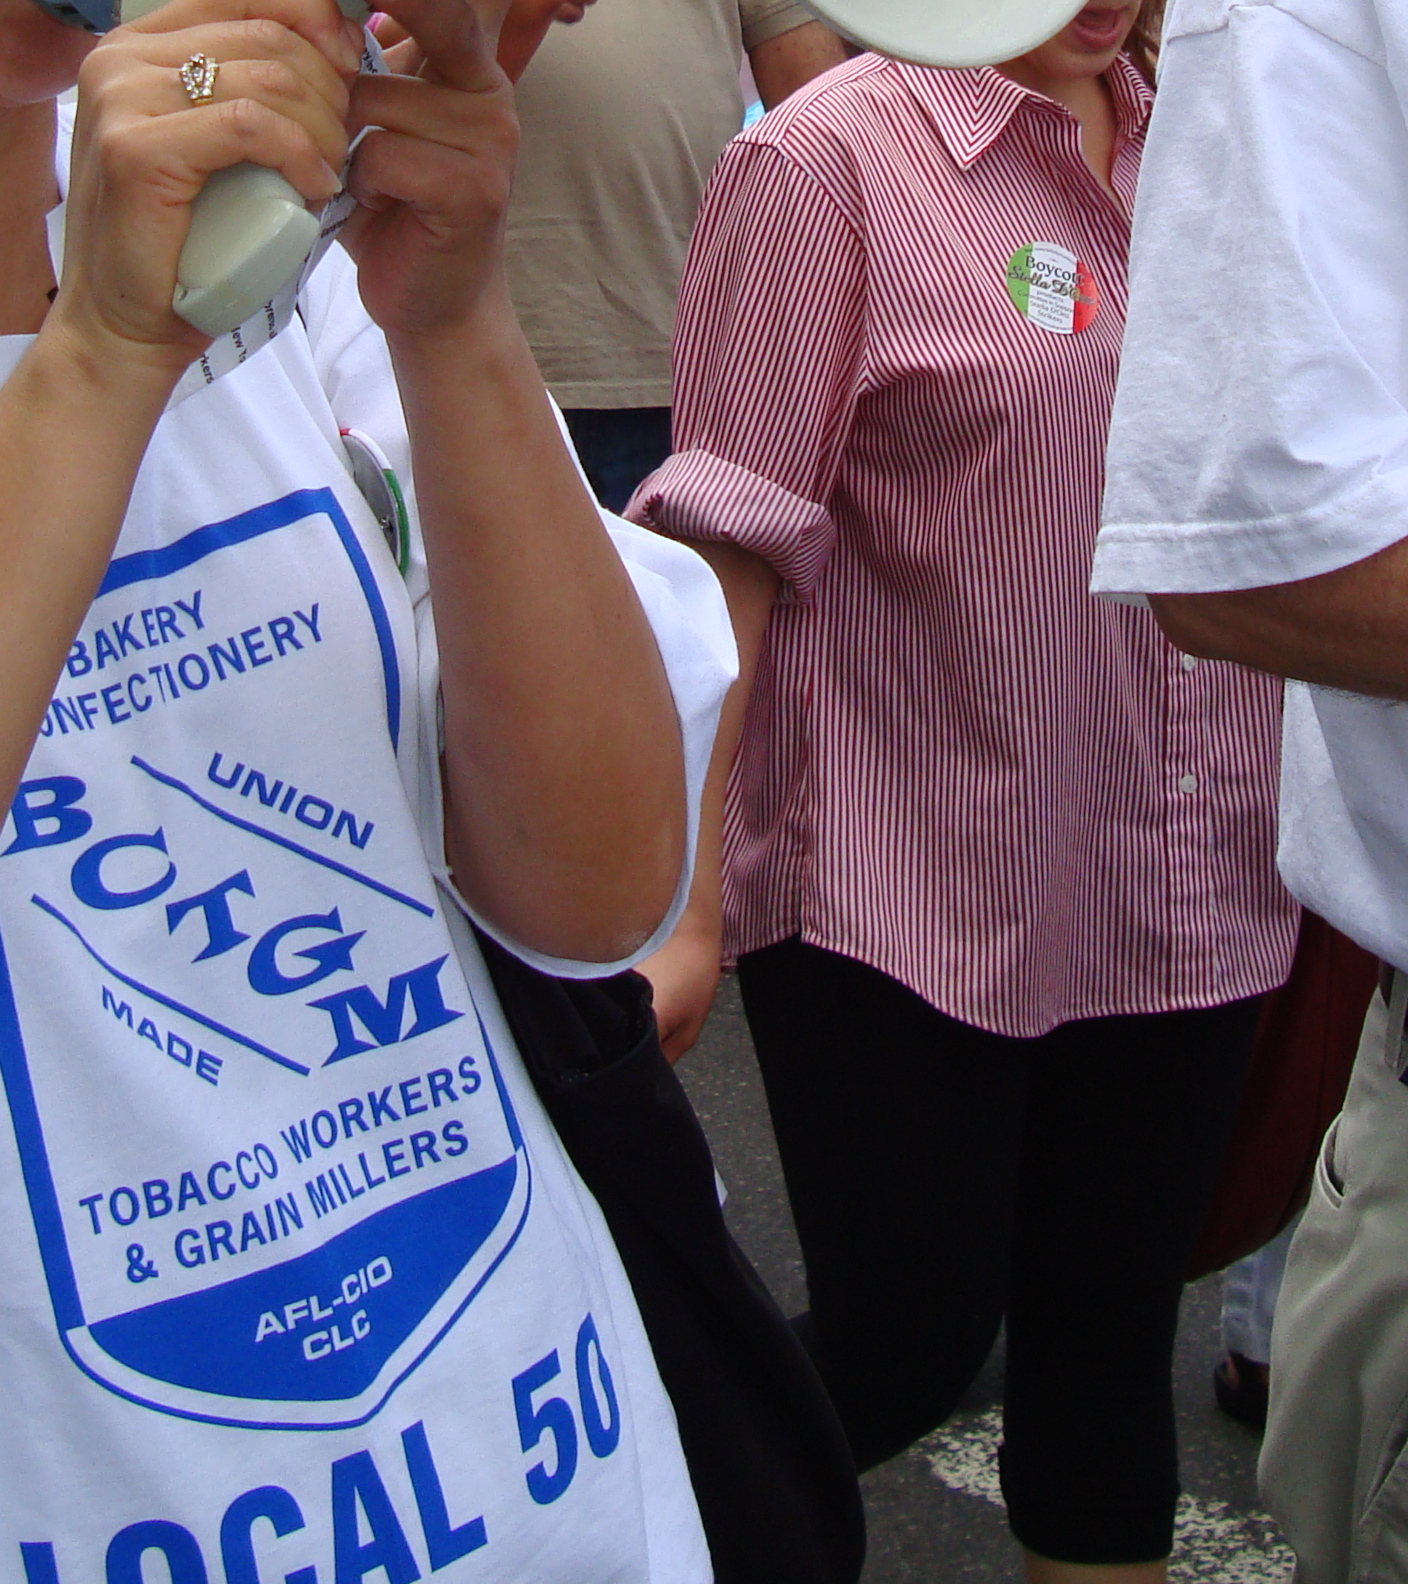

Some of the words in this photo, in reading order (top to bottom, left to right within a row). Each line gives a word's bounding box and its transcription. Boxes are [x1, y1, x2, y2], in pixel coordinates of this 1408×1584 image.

[1025, 255, 1085, 287] Boycott
[38, 601, 323, 738] NFECTIONERY
[65, 589, 206, 678] BAKERY
[206, 751, 375, 852] UNION
[100, 983, 224, 1086] MADE
[78, 1142, 280, 1237] TOBACCO
[280, 1054, 483, 1164] WORKERS
[124, 1242, 160, 1285] &
[173, 1190, 304, 1270] GRAIN
[305, 1120, 471, 1220] MILLERS
[253, 1254, 394, 1344] AFL-CIO
[302, 1308, 372, 1362] CLC
[508, 1311, 622, 1506] 50
